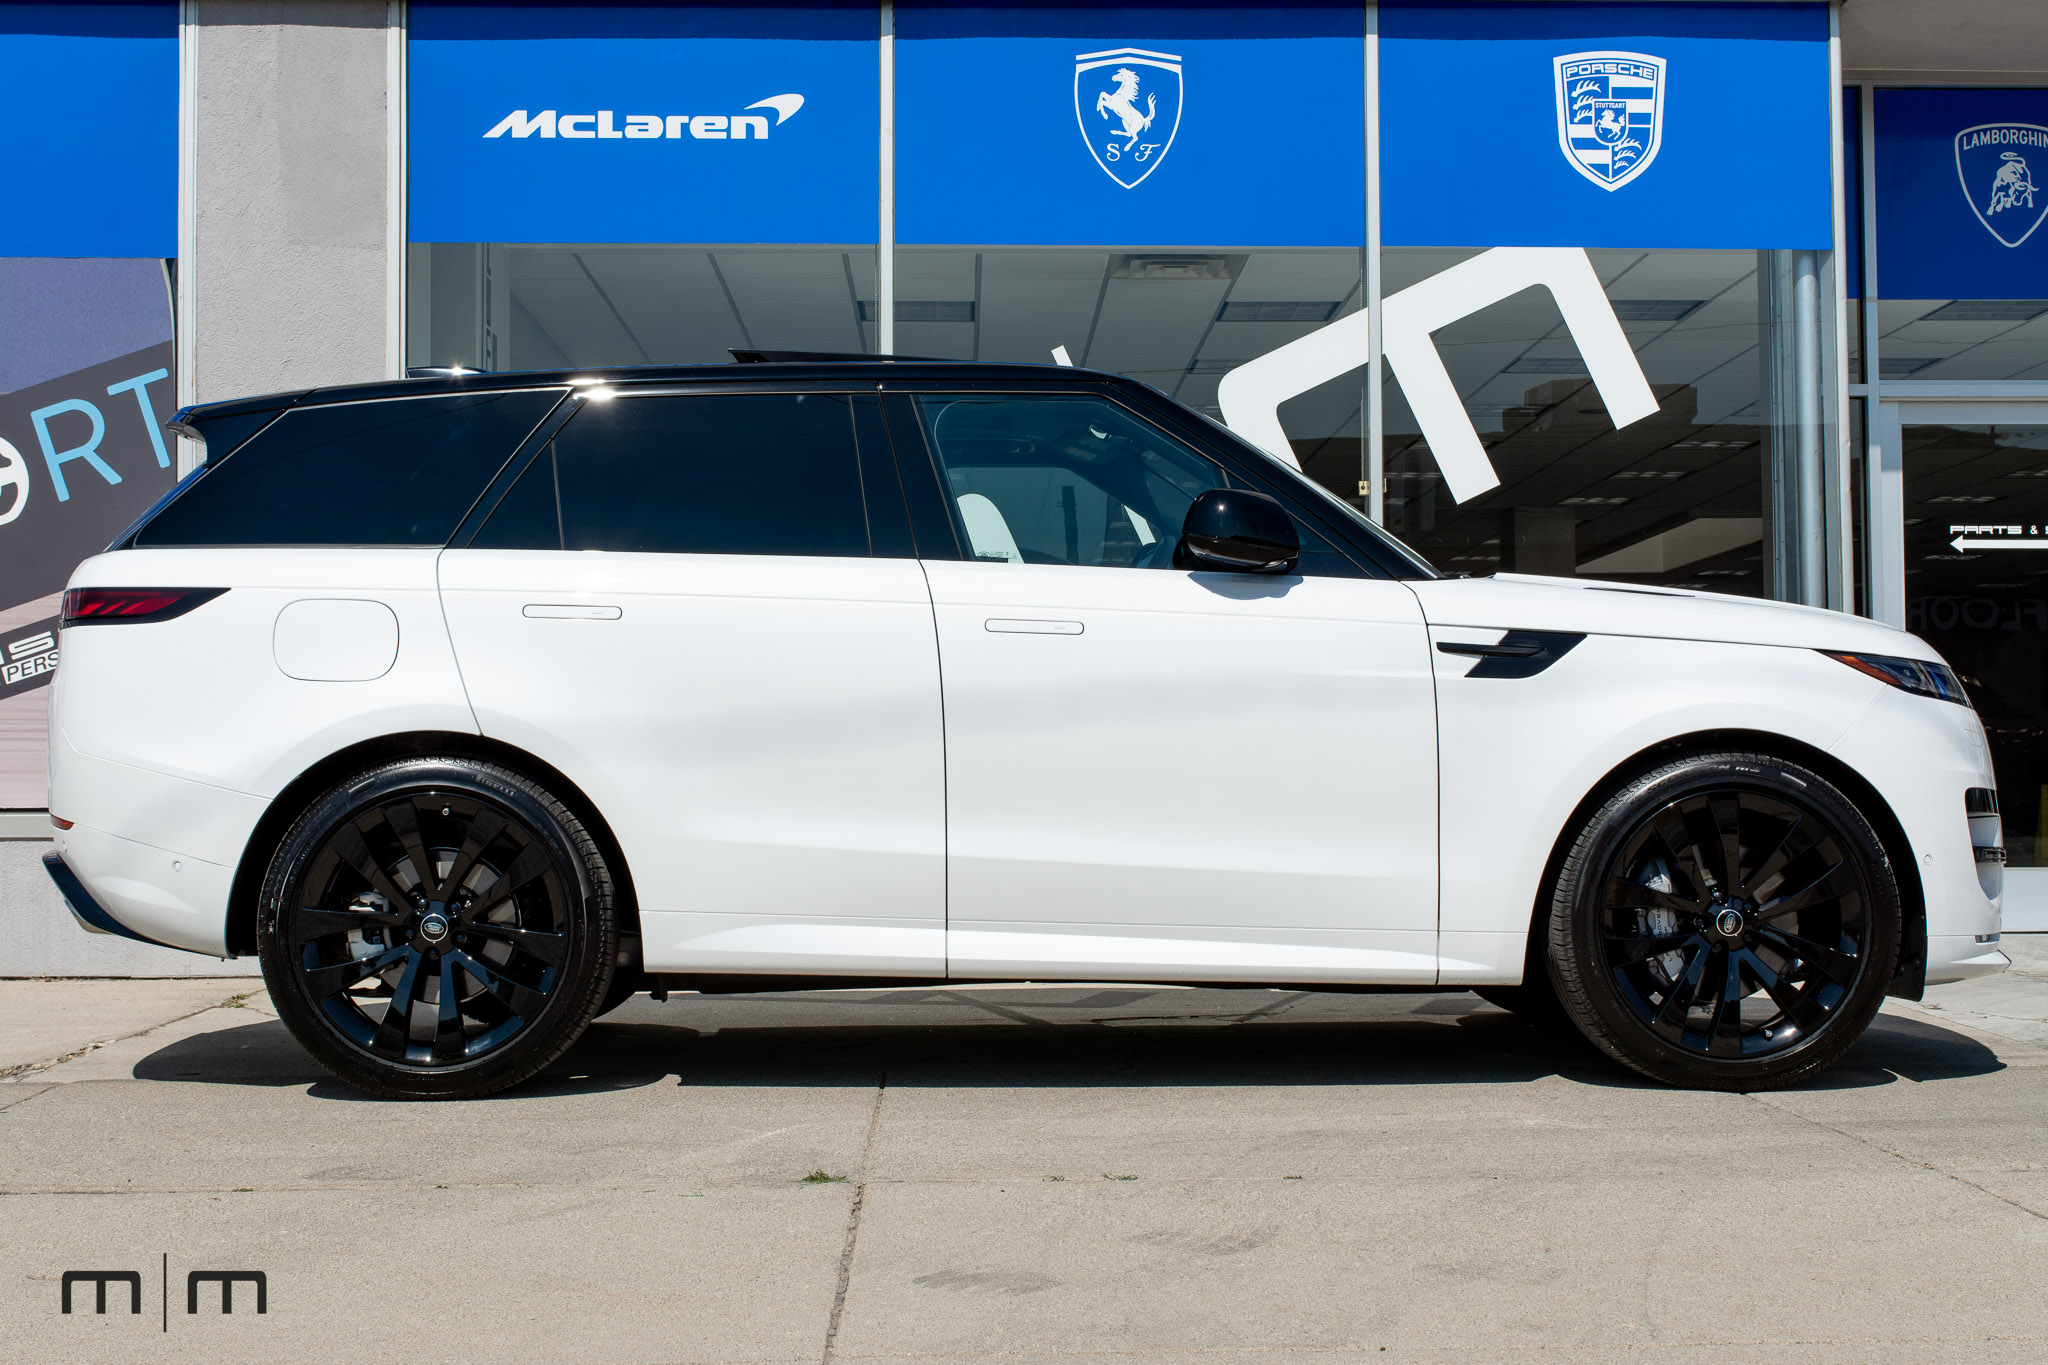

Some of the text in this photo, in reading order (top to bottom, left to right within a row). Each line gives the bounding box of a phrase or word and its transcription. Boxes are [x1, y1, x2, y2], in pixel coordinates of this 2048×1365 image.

[1565, 63, 1655, 80] PORSCHE
[482, 109, 769, 140] McLaren
[1950, 525, 2022, 535] PARTS
[2030, 525, 2039, 535] &
